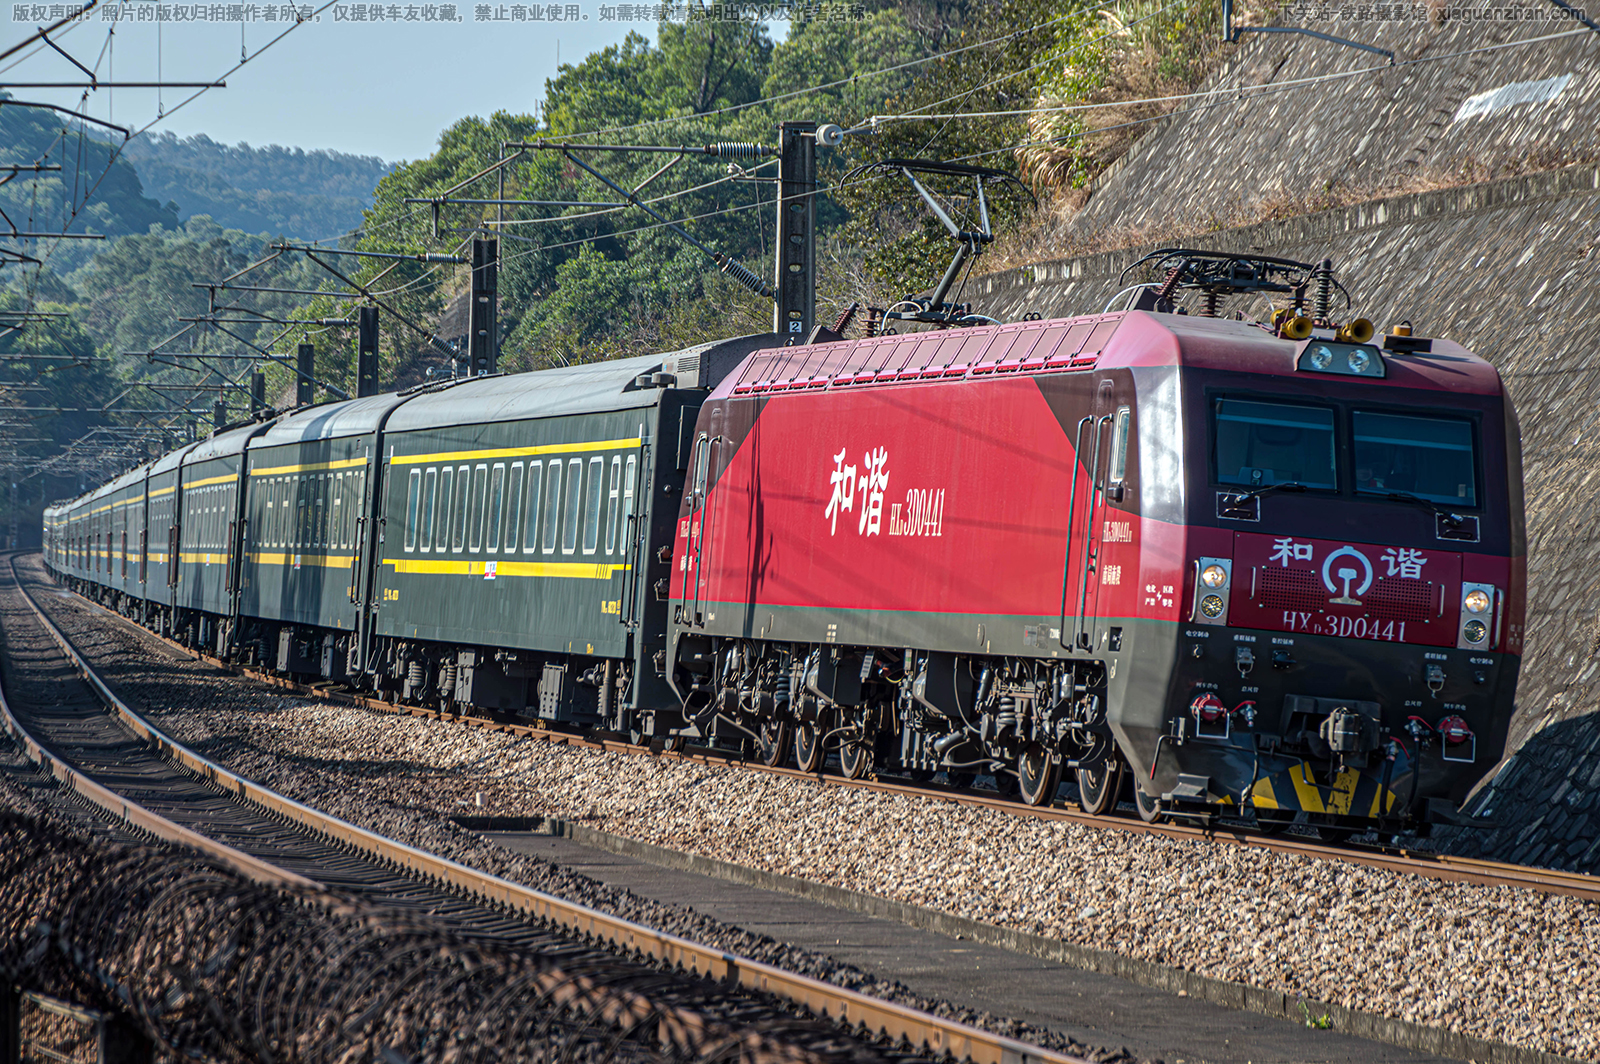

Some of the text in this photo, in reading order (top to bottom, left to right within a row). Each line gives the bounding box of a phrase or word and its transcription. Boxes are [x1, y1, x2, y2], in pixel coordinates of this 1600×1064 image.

[824, 445, 890, 537] 和谐
[1269, 537, 1428, 579] 和 谐
